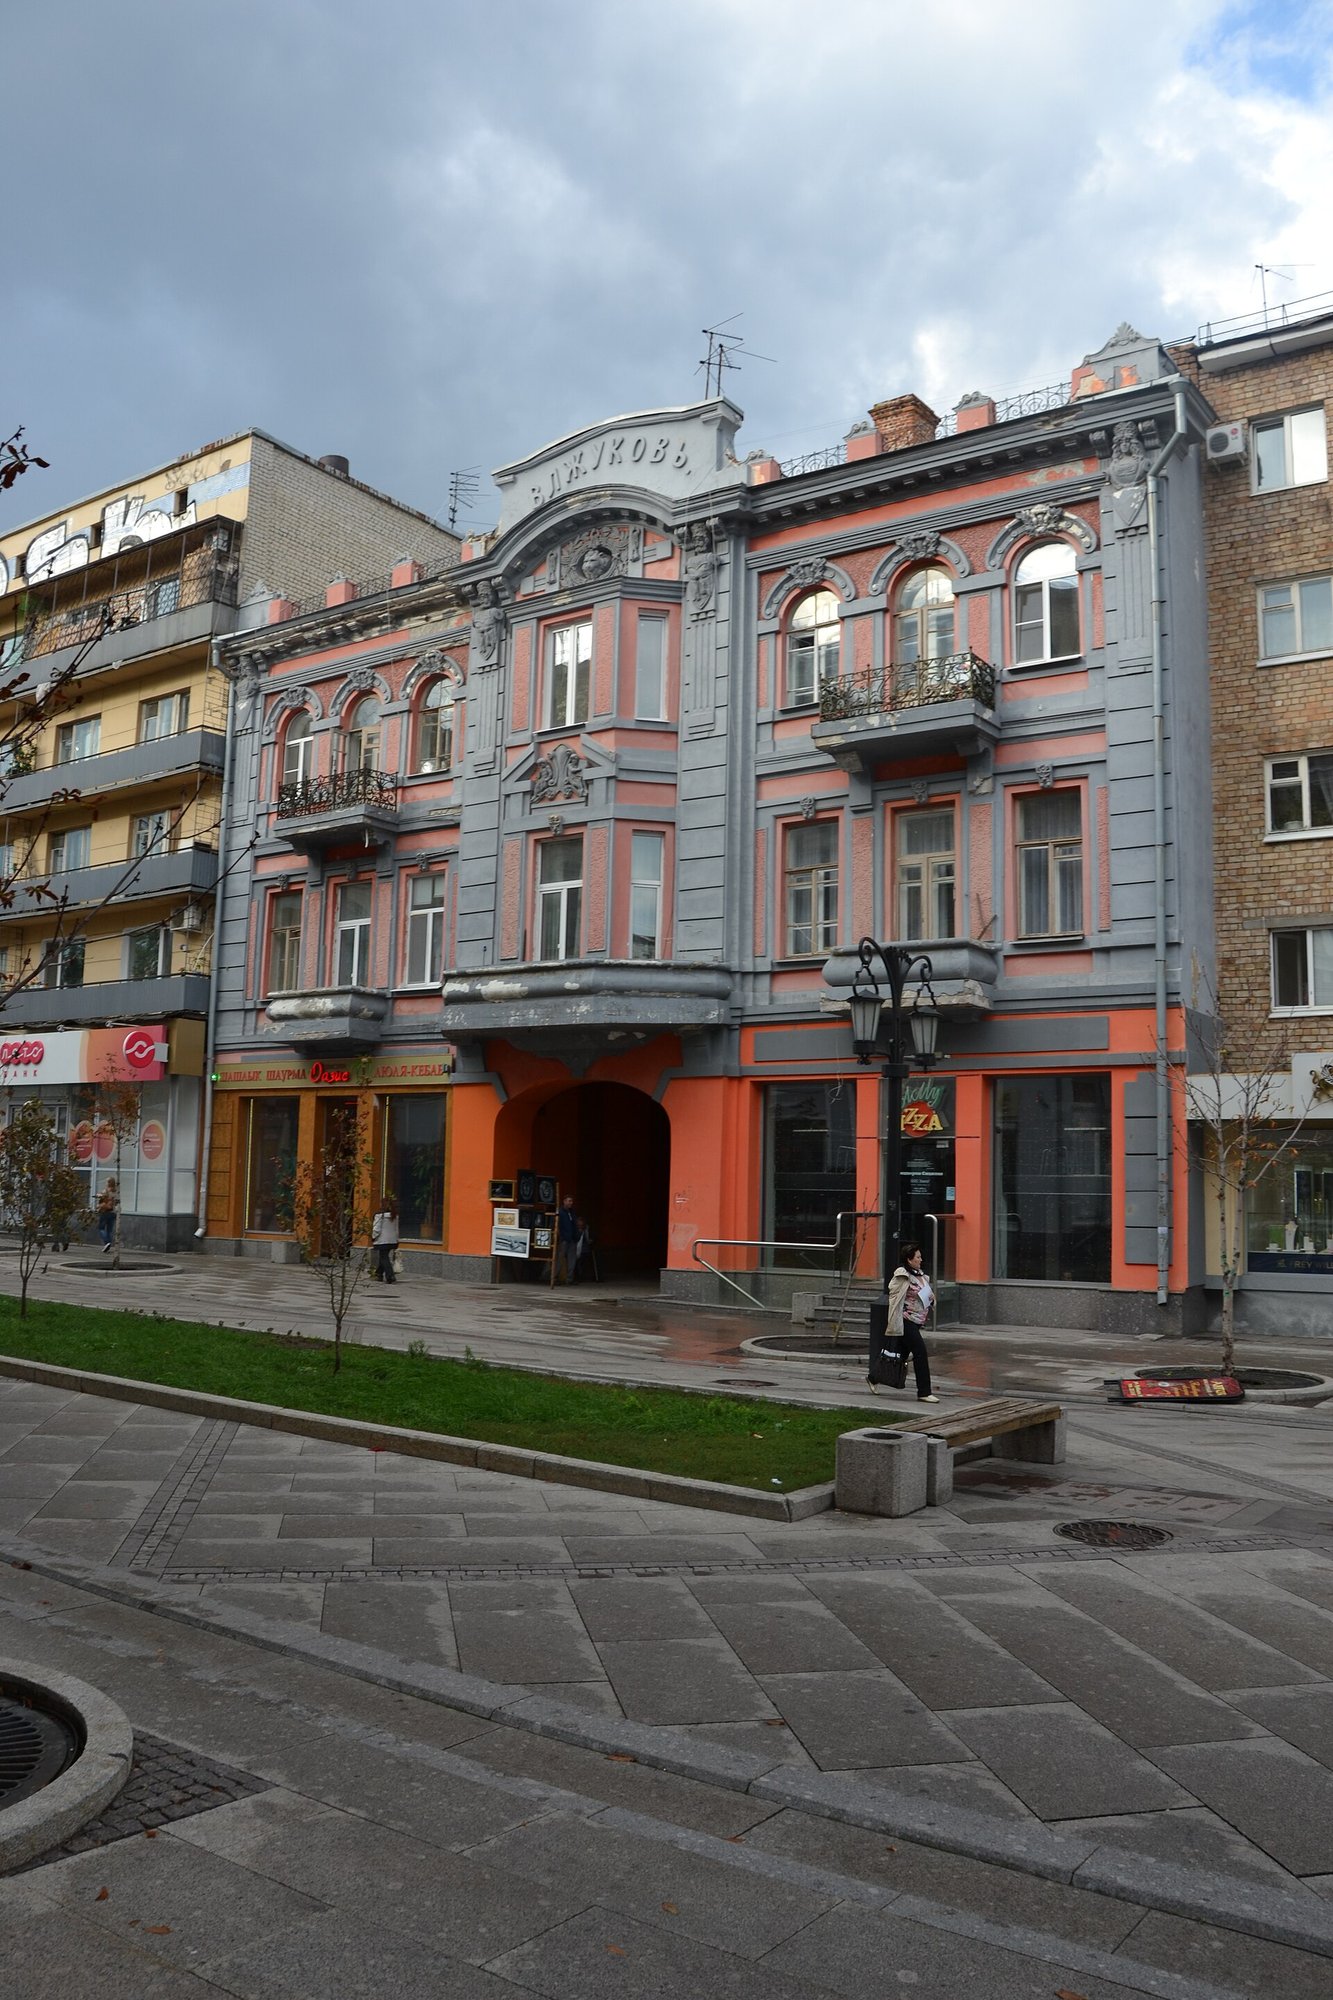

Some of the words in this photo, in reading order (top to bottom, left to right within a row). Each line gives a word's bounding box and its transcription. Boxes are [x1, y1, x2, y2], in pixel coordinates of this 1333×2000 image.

[220, 1071, 262, 1083] ШАШЛЫК
[266, 1069, 307, 1082] ШАУРМА
[309, 1061, 351, 1083] Оазис
